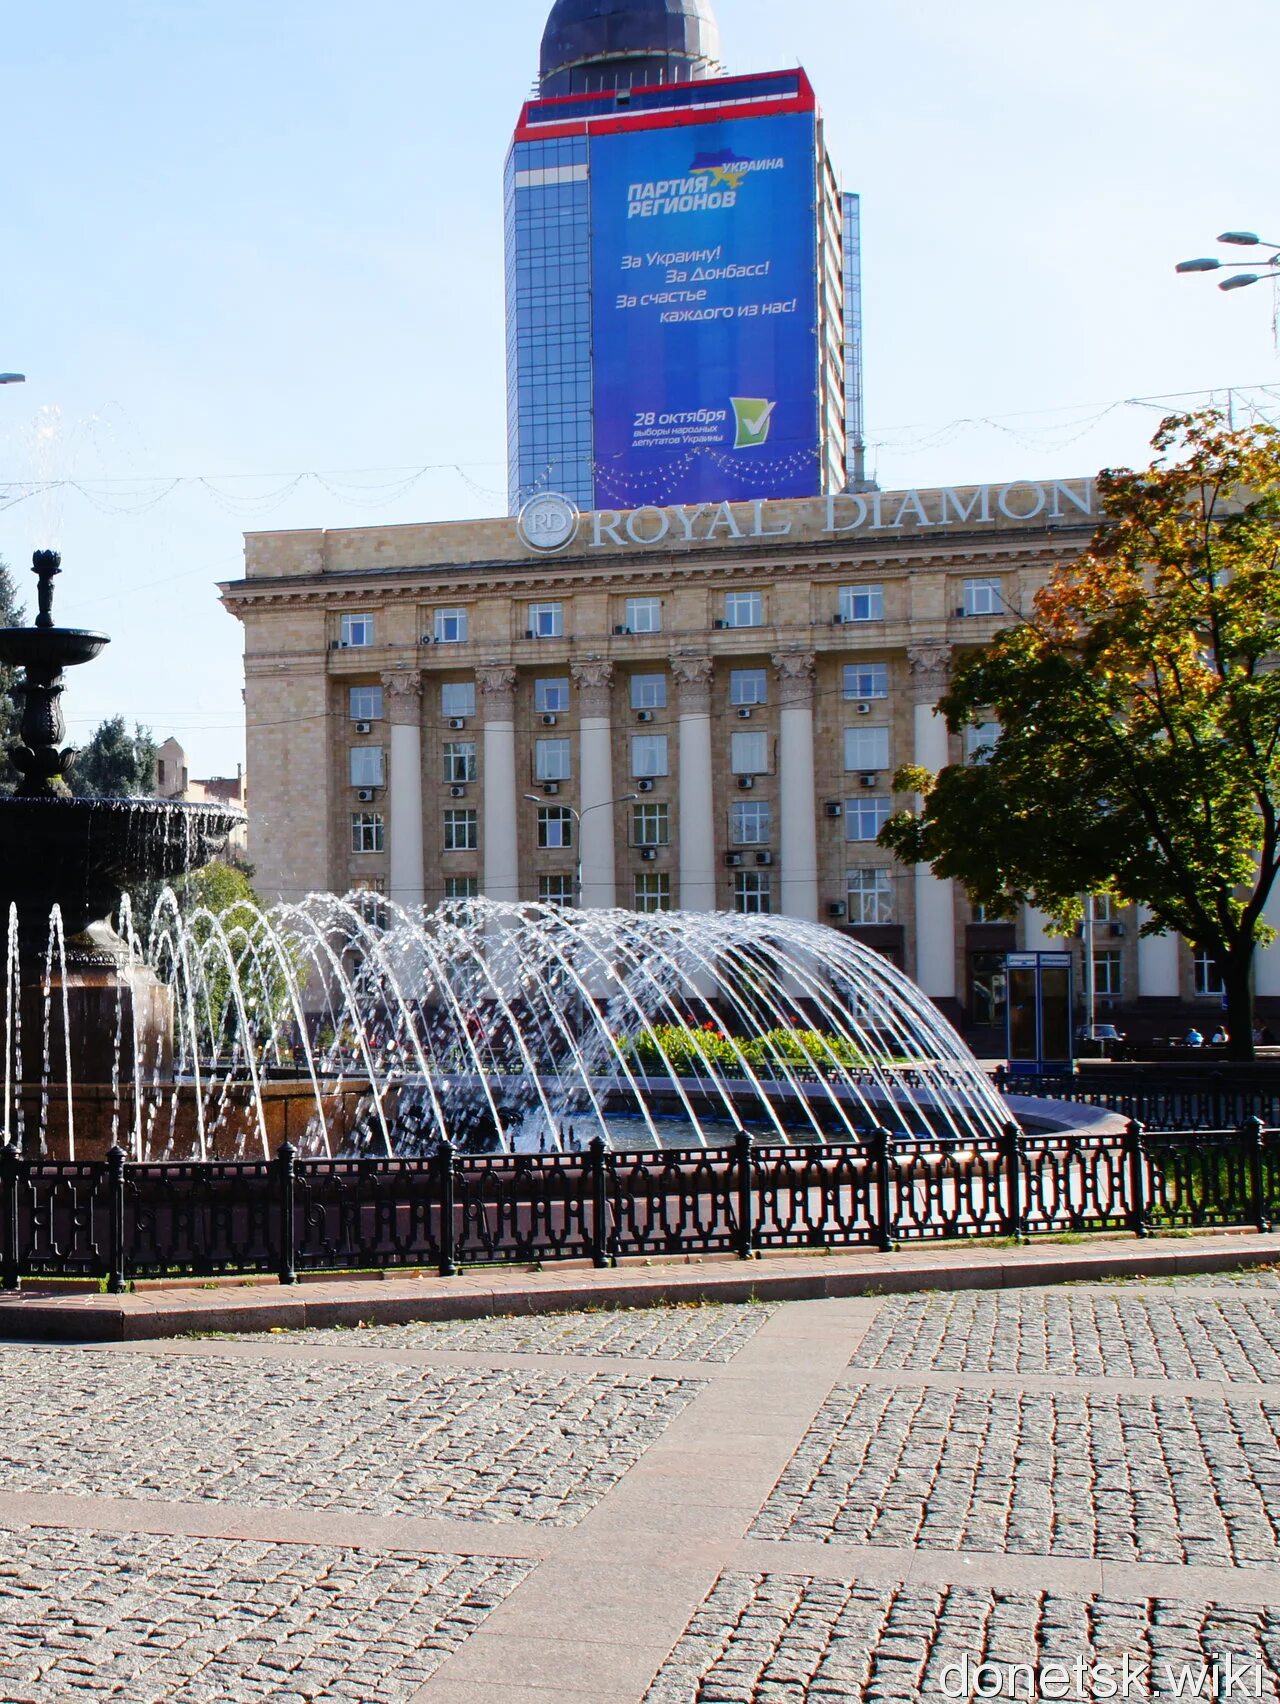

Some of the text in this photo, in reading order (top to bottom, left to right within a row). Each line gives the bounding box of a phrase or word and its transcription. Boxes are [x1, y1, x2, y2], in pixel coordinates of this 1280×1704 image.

[721, 157, 784, 174] УКРАИНА
[627, 175, 708, 202] ПАРТИЯ
[627, 191, 737, 219] РЕГИОНОВ
[620, 246, 721, 270] За Украину!
[665, 261, 770, 284] За Донбасс!
[615, 289, 707, 309] За счастье
[660, 299, 797, 324] каждого из нас!
[633, 409, 726, 427] 28 октября
[632, 434, 723, 447] депутатов Украины
[633, 425, 717, 437] выборы народных
[528, 511, 567, 534] RD
[588, 476, 1112, 547] ROYAL DIAMON
